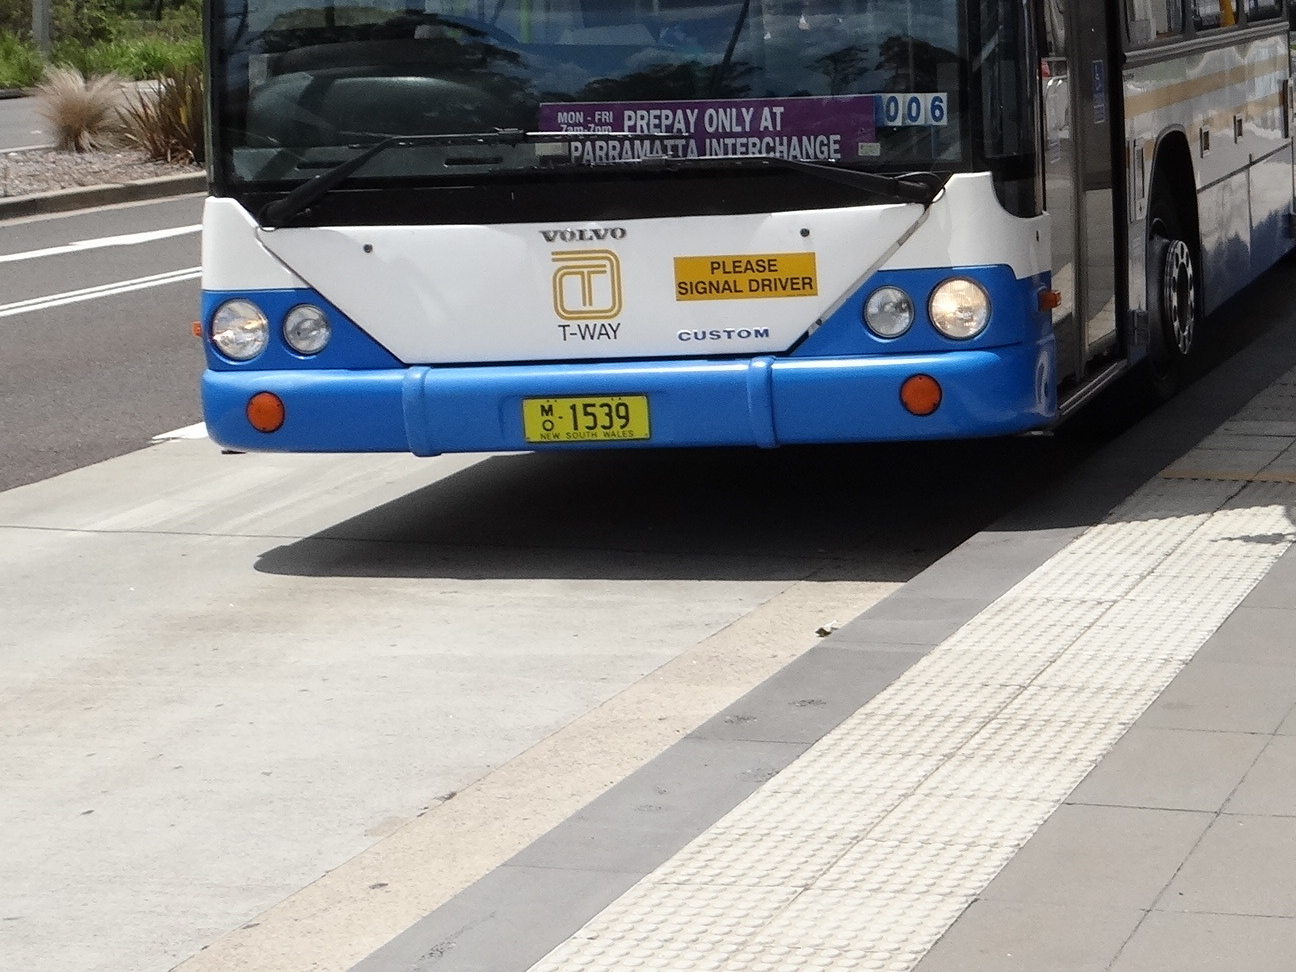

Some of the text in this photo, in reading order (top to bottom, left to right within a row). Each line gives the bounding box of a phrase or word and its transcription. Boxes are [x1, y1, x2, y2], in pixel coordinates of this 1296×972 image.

[557, 111, 584, 124] MON
[594, 111, 613, 123] FRI
[884, 95, 945, 123] 006
[623, 106, 785, 134] PREPAY ONLY AT
[570, 138, 699, 164] PARRAMATTA
[705, 134, 841, 160] INTERCHANGE
[539, 227, 627, 242] VOLVO
[710, 258, 778, 275] PLEASE
[677, 277, 813, 295] SIGNAL DRIVER
[557, 322, 621, 341] T-WAY
[677, 328, 770, 341] CUSTOM
[570, 402, 630, 431] 1539
[565, 431, 598, 439] SOUTH
[603, 430, 634, 438] WALES
